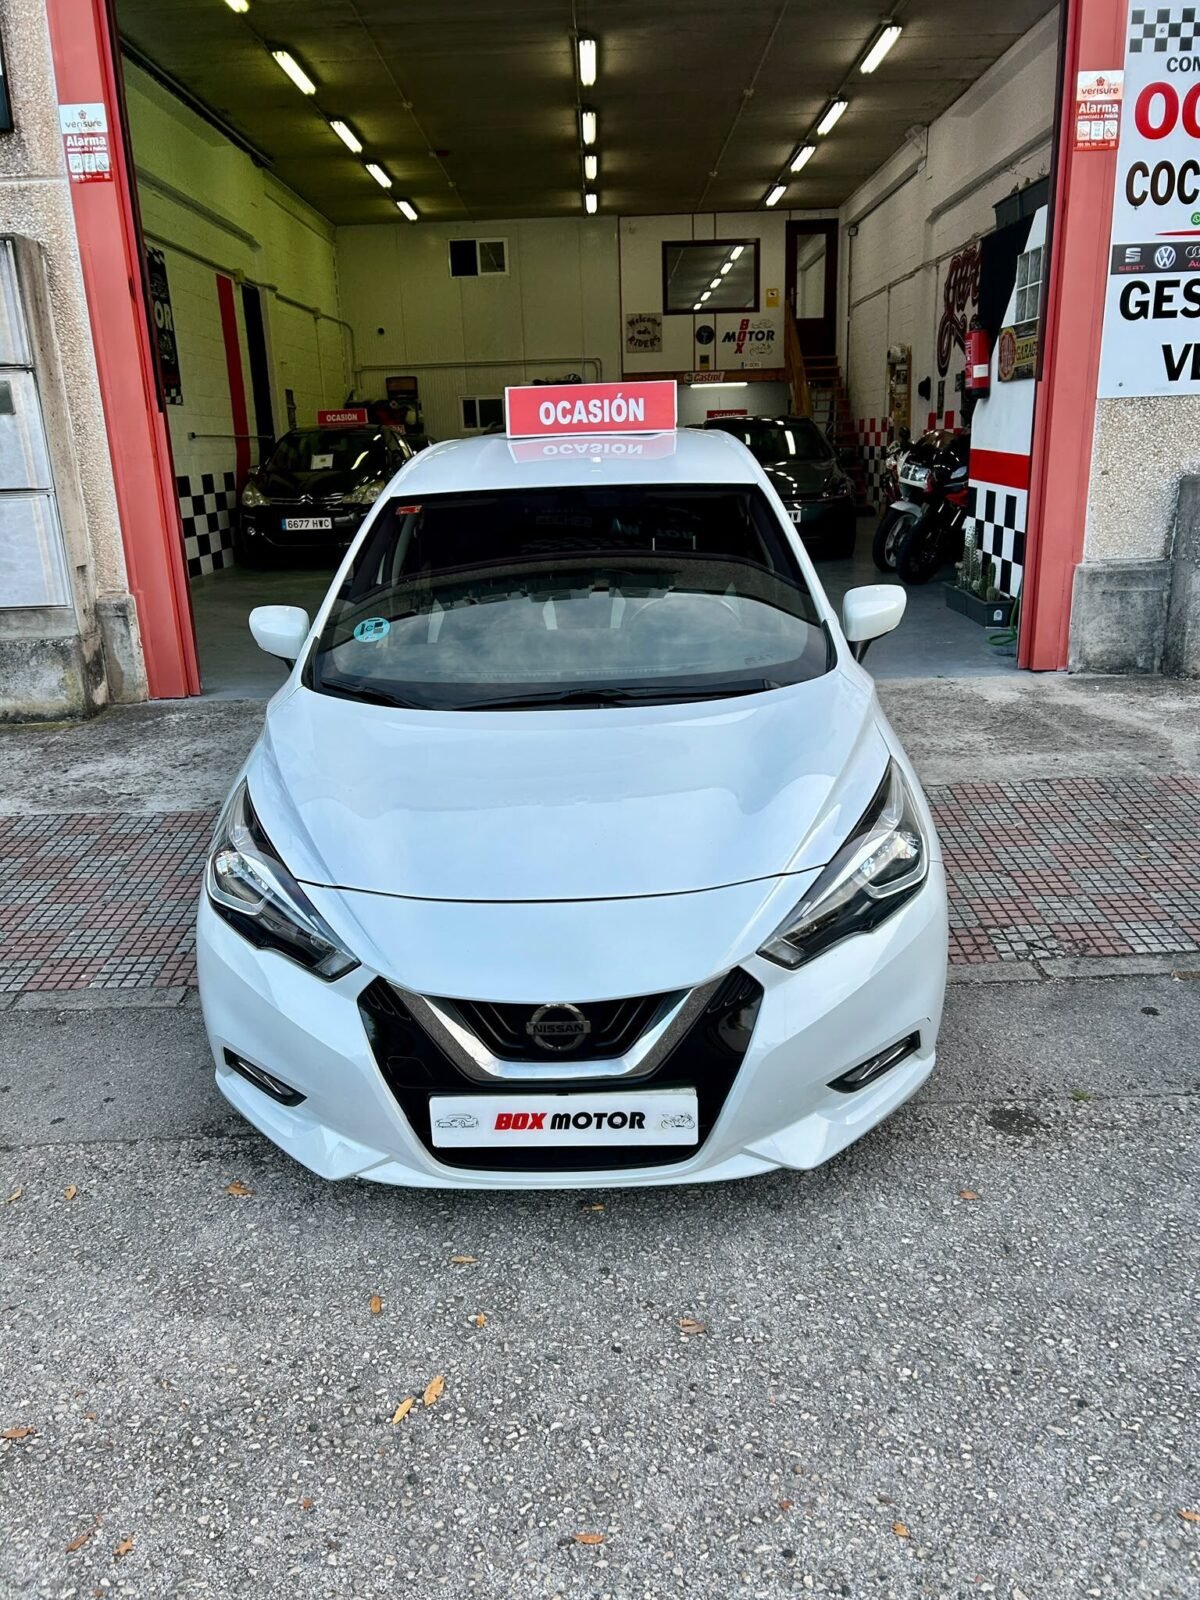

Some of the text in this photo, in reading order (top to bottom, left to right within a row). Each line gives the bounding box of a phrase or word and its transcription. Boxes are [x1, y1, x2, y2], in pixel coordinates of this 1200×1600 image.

[1078, 103, 1119, 114] Alarma
[67, 135, 107, 147] Alarma
[1125, 159, 1200, 207] COC
[1119, 278, 1200, 320] GES
[694, 372, 722, 382] Castrol
[538, 393, 645, 426] OCASIÓN
[287, 519, 310, 528] 6677
[532, 1023, 584, 1033] NISSAN
[494, 1111, 646, 1130] BOX MOTOR
